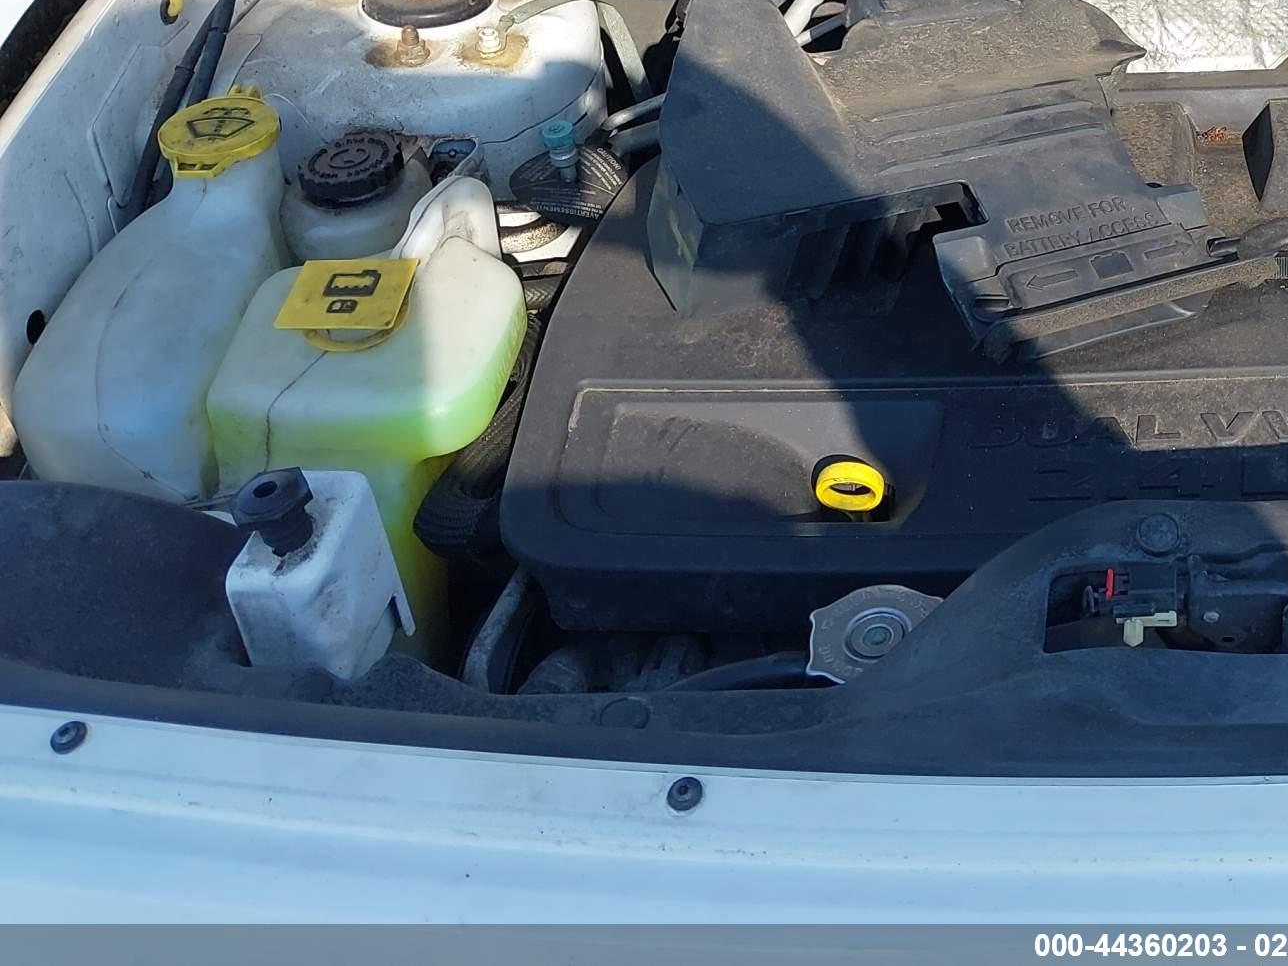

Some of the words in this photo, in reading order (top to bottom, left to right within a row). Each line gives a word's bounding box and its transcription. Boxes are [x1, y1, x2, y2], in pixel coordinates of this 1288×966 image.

[1006, 205, 1080, 234] REMOVE
[1087, 196, 1127, 219] FOR
[1003, 230, 1082, 259] BATTERY
[1087, 212, 1157, 243] ACCESS
[969, 413, 1182, 448] DUAL
